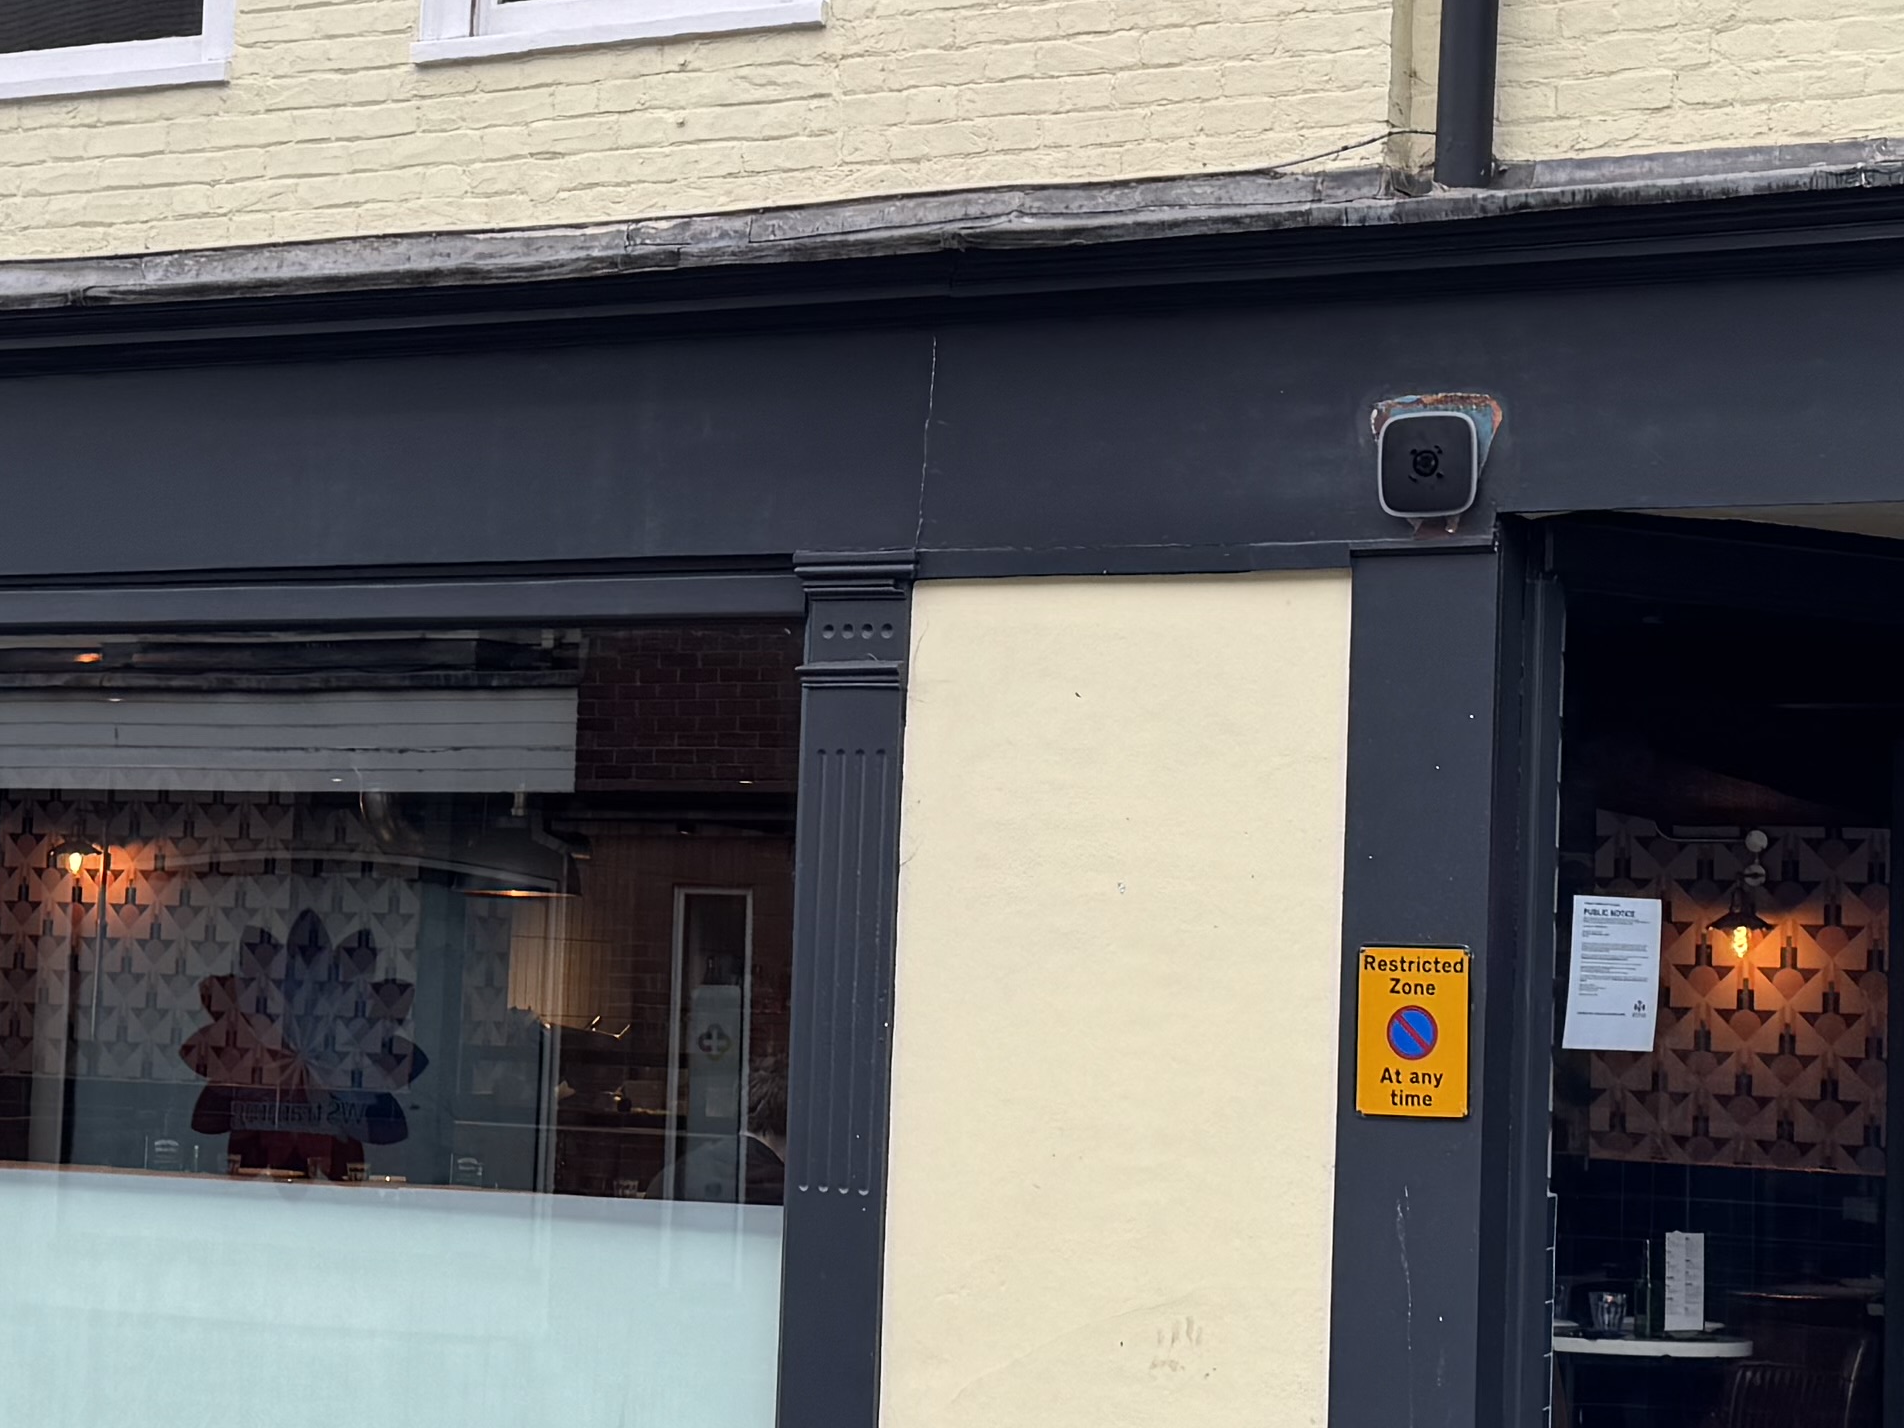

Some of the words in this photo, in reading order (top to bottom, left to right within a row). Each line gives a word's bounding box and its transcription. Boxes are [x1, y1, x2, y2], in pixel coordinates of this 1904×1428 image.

[1364, 955, 1464, 973] Restricted
[1389, 978, 1436, 995] Zone
[1380, 1067, 1402, 1084] At
[1410, 1072, 1443, 1088] any
[1391, 1090, 1432, 1106] time
